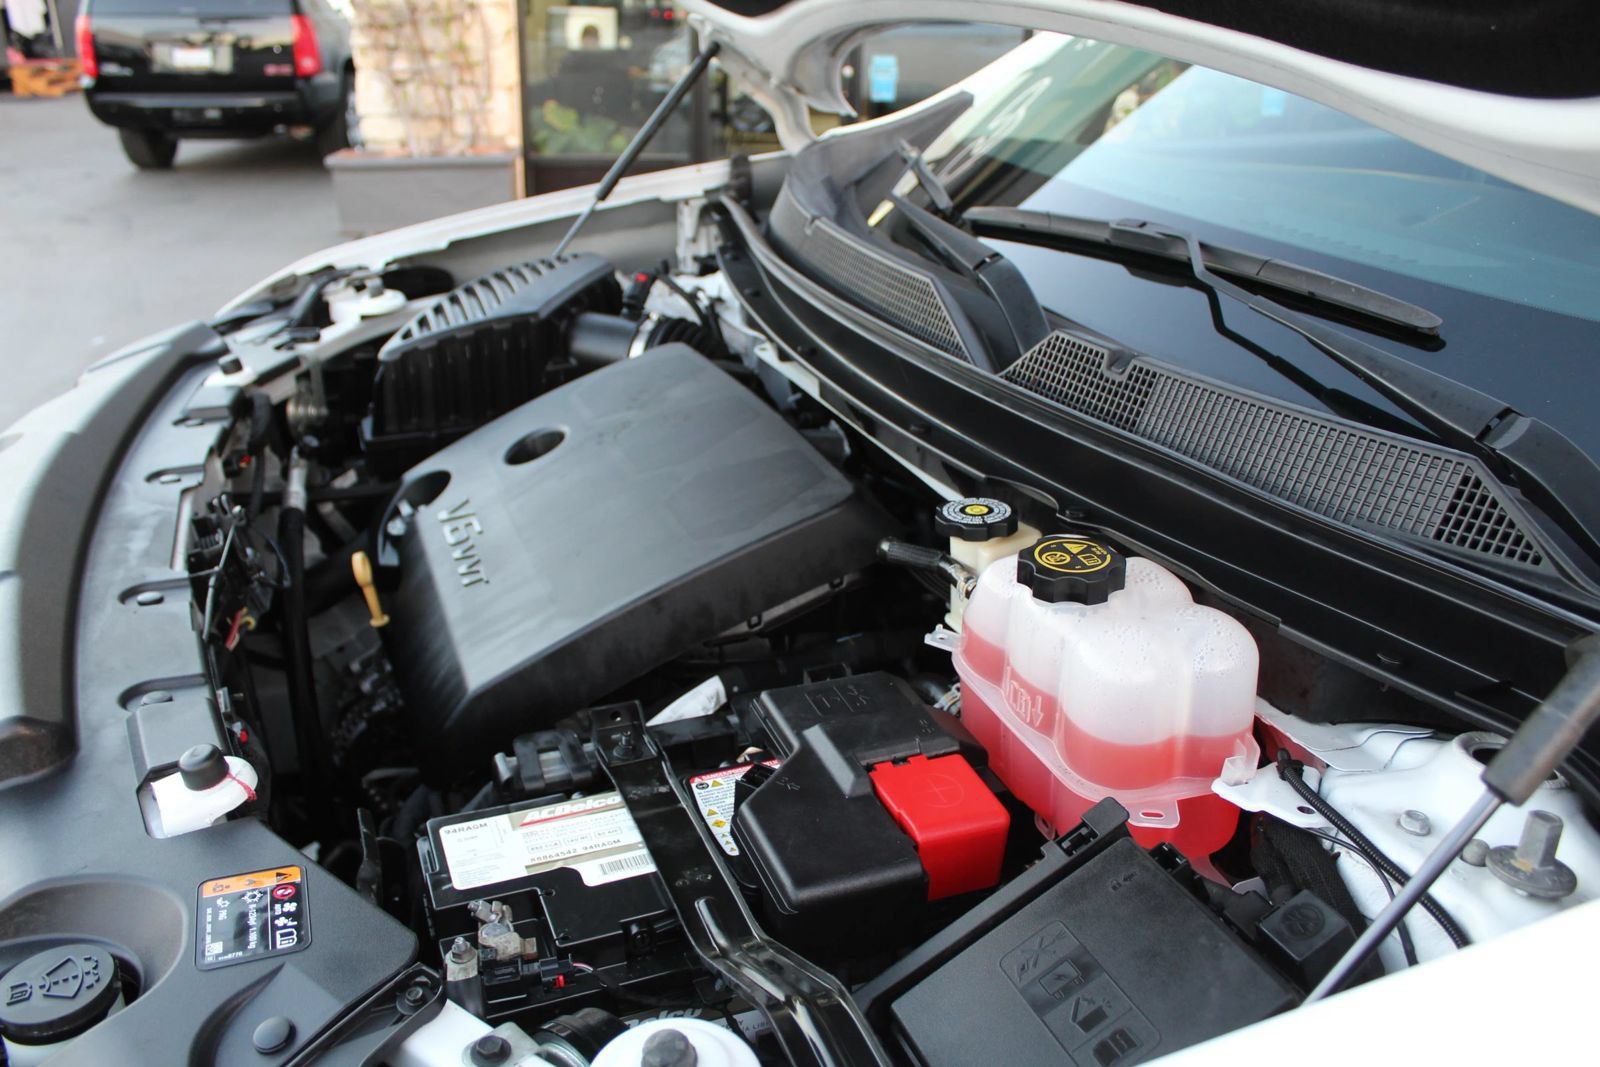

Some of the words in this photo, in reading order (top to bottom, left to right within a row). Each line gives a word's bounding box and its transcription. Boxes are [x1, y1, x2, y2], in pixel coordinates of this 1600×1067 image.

[437, 498, 483, 547] V6
[523, 796, 618, 823] ACDelco
[445, 822, 488, 835] 94RAGM
